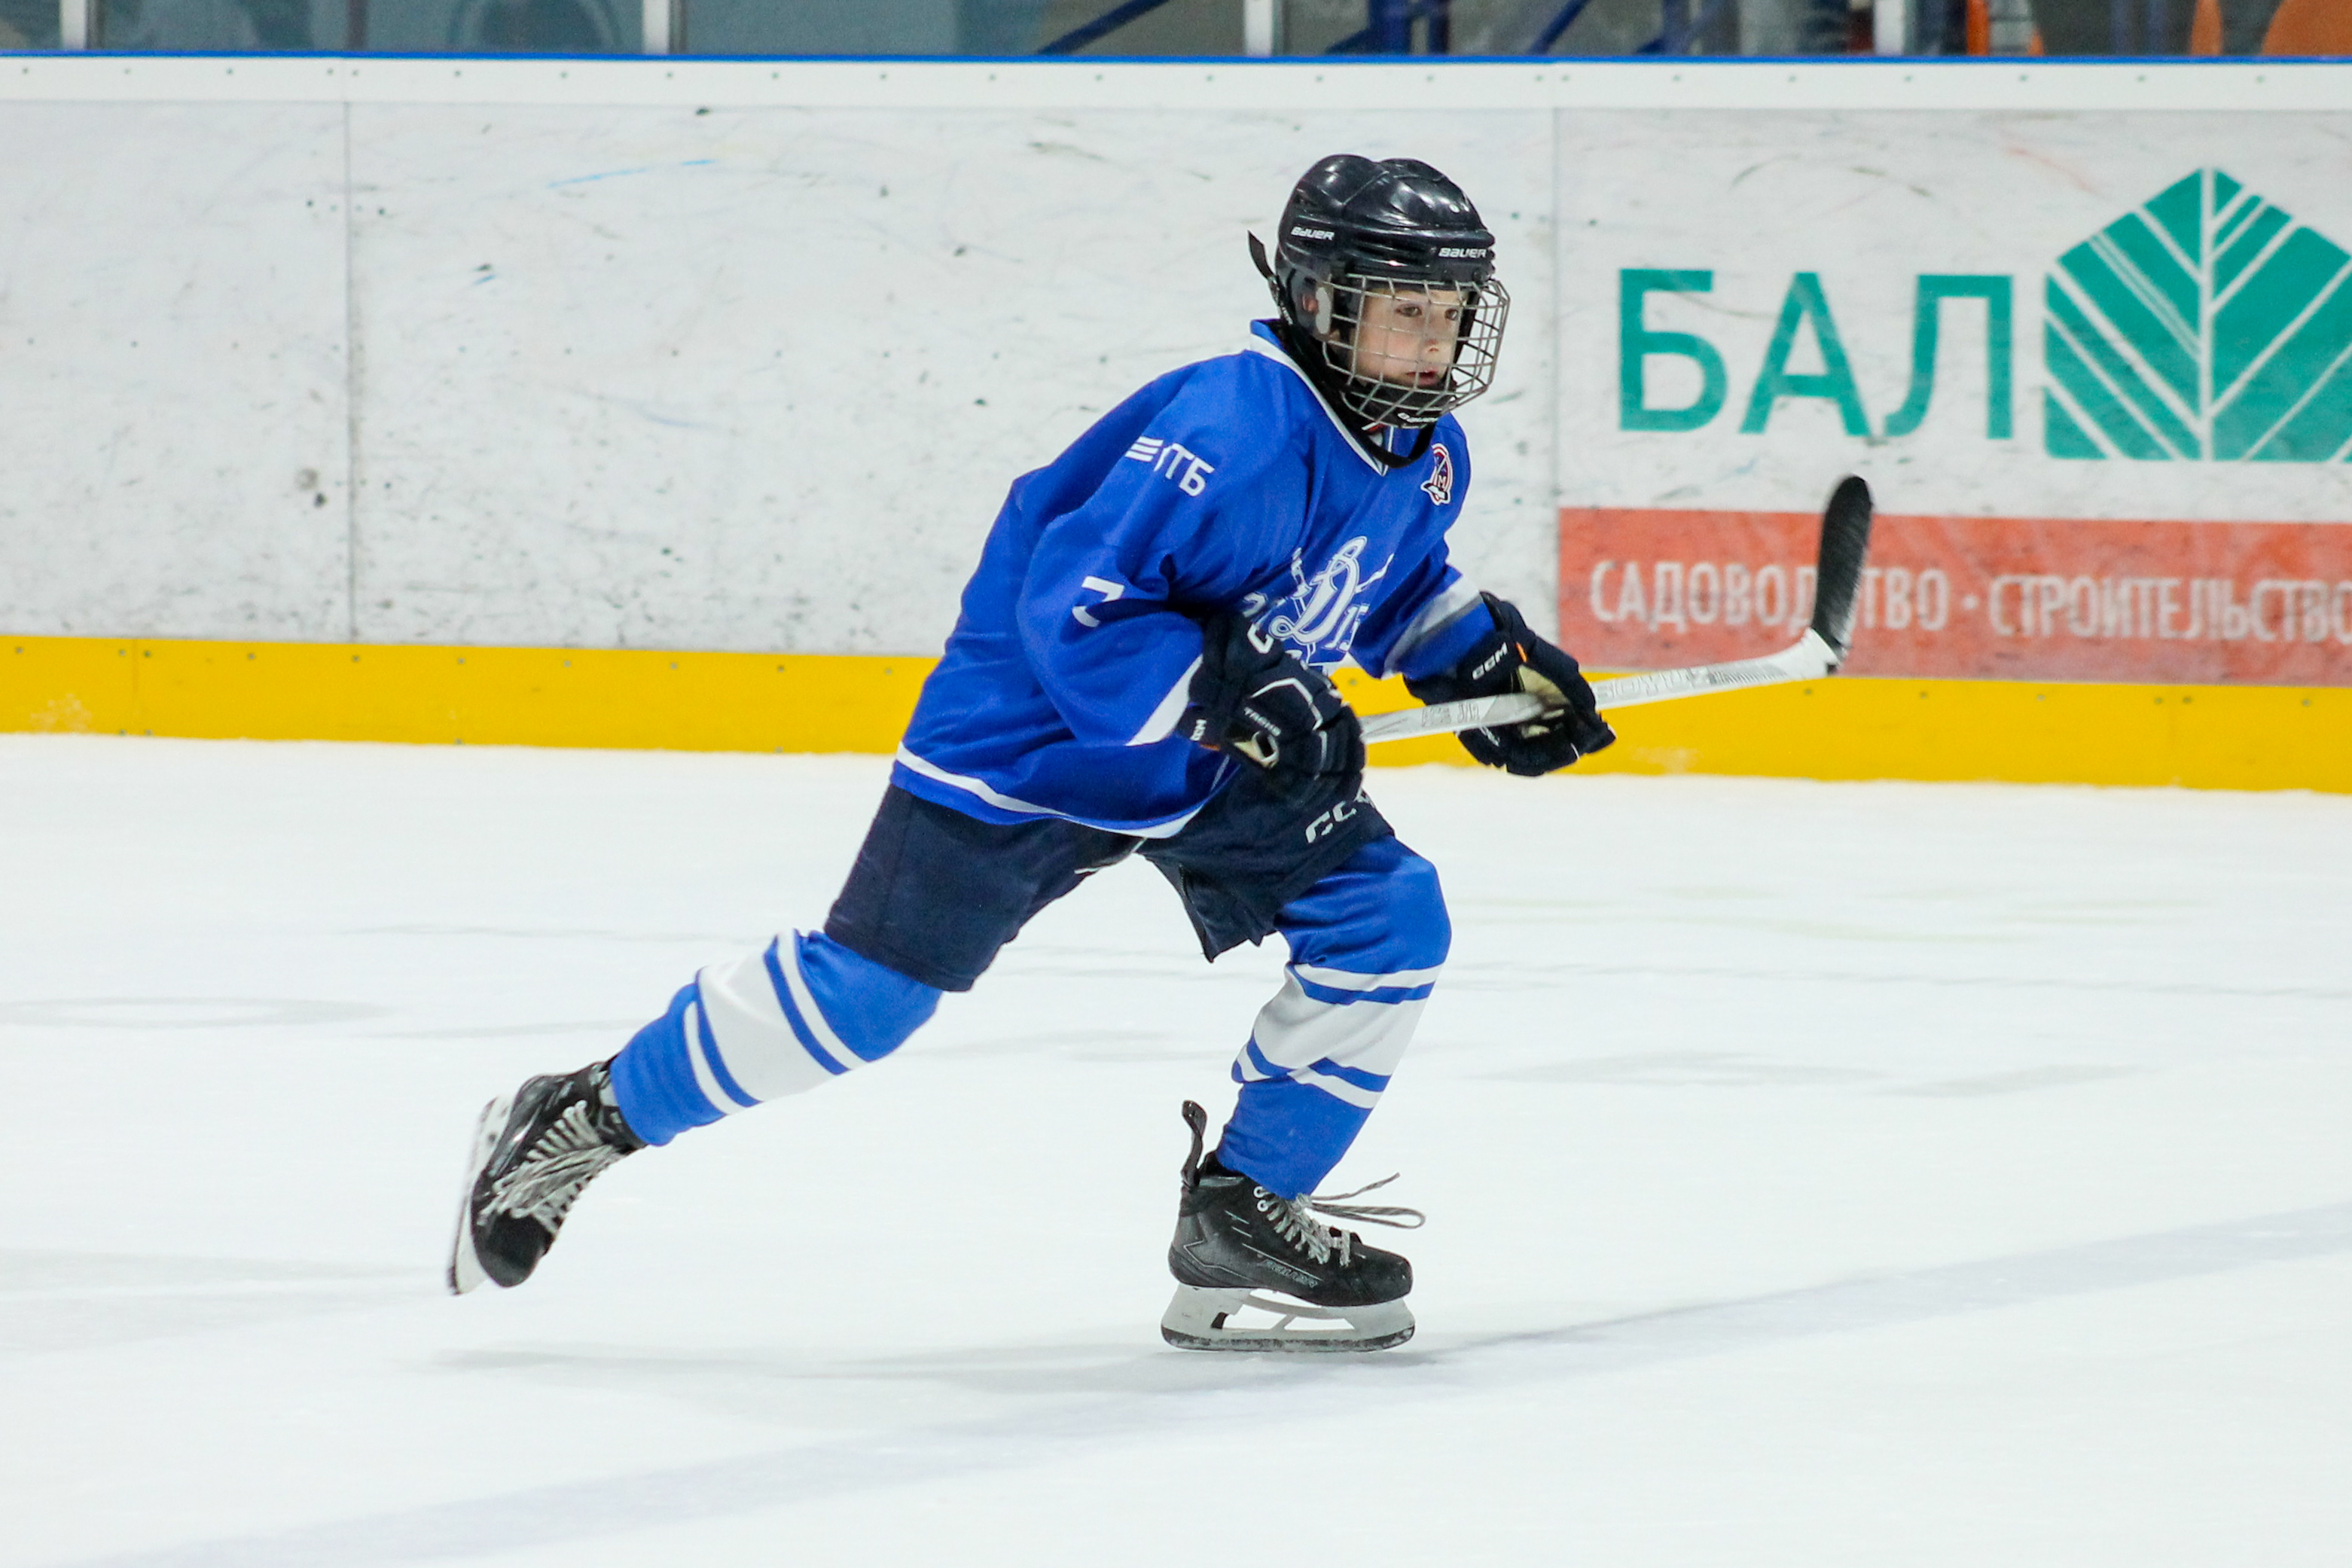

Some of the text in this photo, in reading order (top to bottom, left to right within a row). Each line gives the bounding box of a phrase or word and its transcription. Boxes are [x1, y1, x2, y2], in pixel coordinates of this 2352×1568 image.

[1618, 268, 2014, 440] БАЛ
[1590, 560, 1950, 637] САДОВОДТВО
[1472, 641, 1509, 681] CCM
